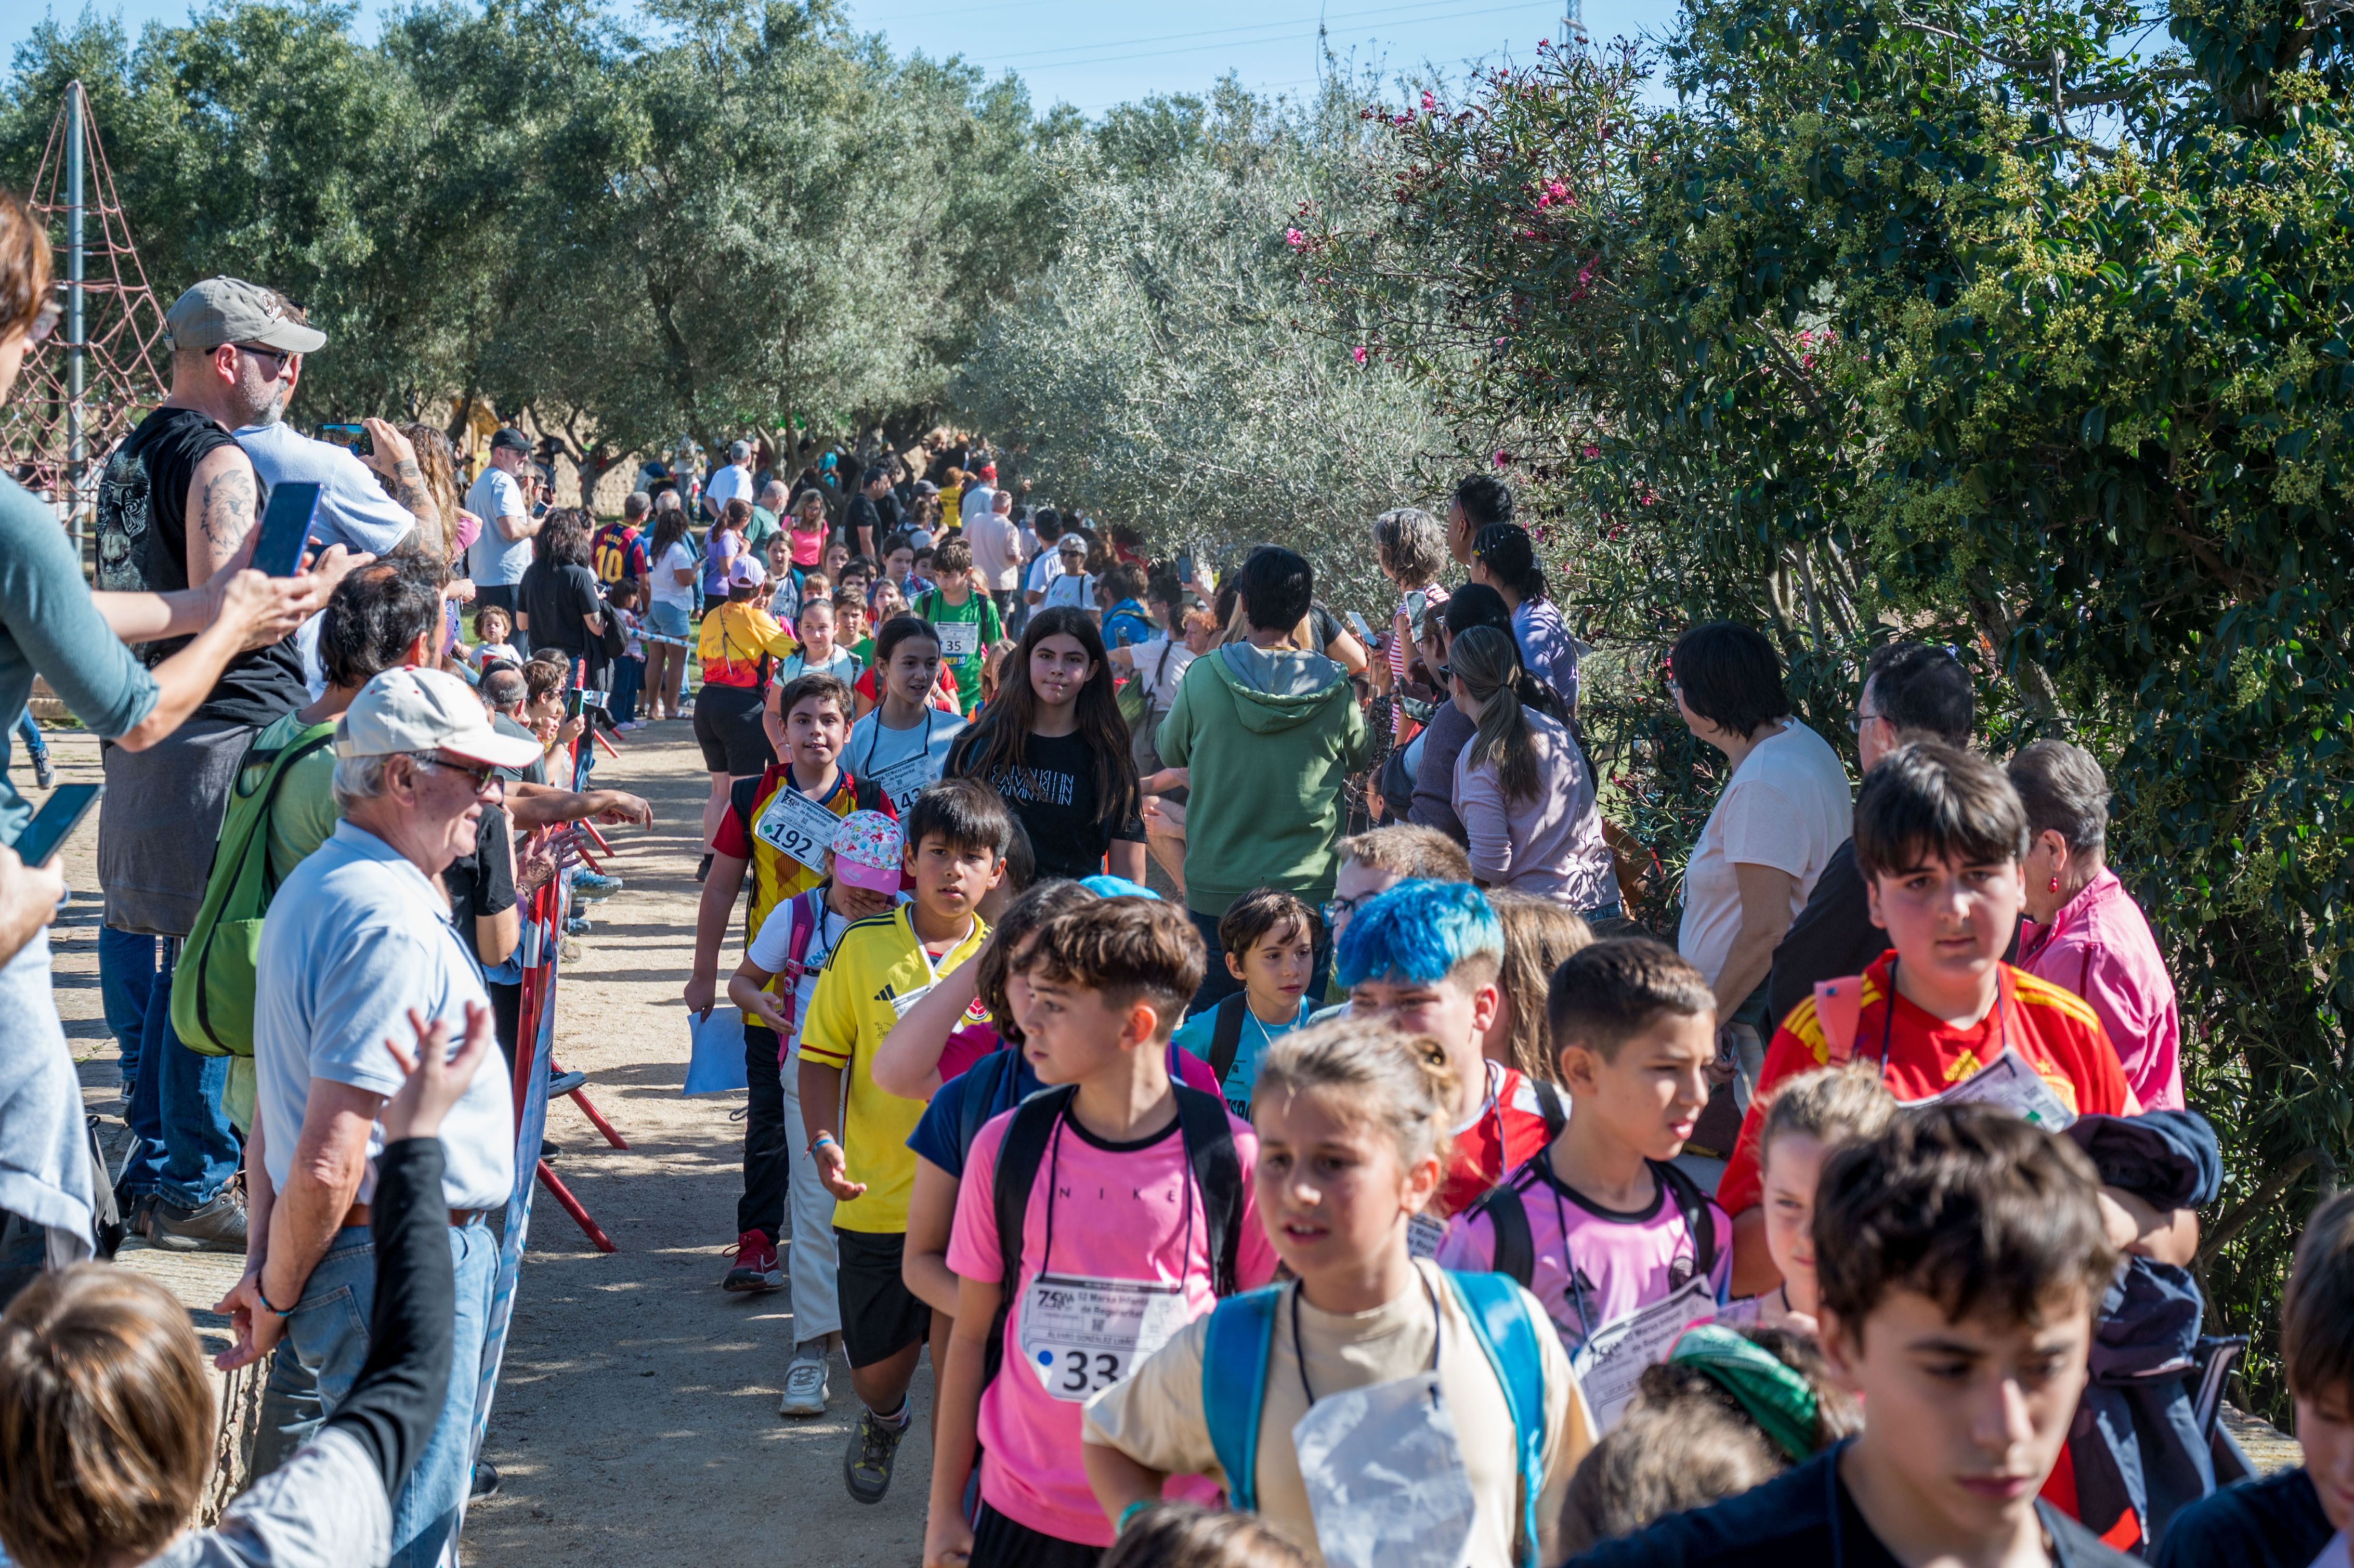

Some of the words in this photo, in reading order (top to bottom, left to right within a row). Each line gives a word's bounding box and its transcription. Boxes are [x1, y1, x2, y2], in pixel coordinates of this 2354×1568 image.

[604, 533, 623, 546] MESSI
[596, 545, 622, 583] 10
[947, 641, 961, 651] 35
[805, 812, 827, 828] Regularitat
[806, 806, 818, 815] Marxa
[818, 812, 832, 824] Infantil
[769, 824, 813, 859] 192
[1090, 1293, 1116, 1304] Marxa
[1081, 1305, 1091, 1314] de
[1094, 1306, 1143, 1318] Regularitat
[1063, 1351, 1119, 1392] 33
